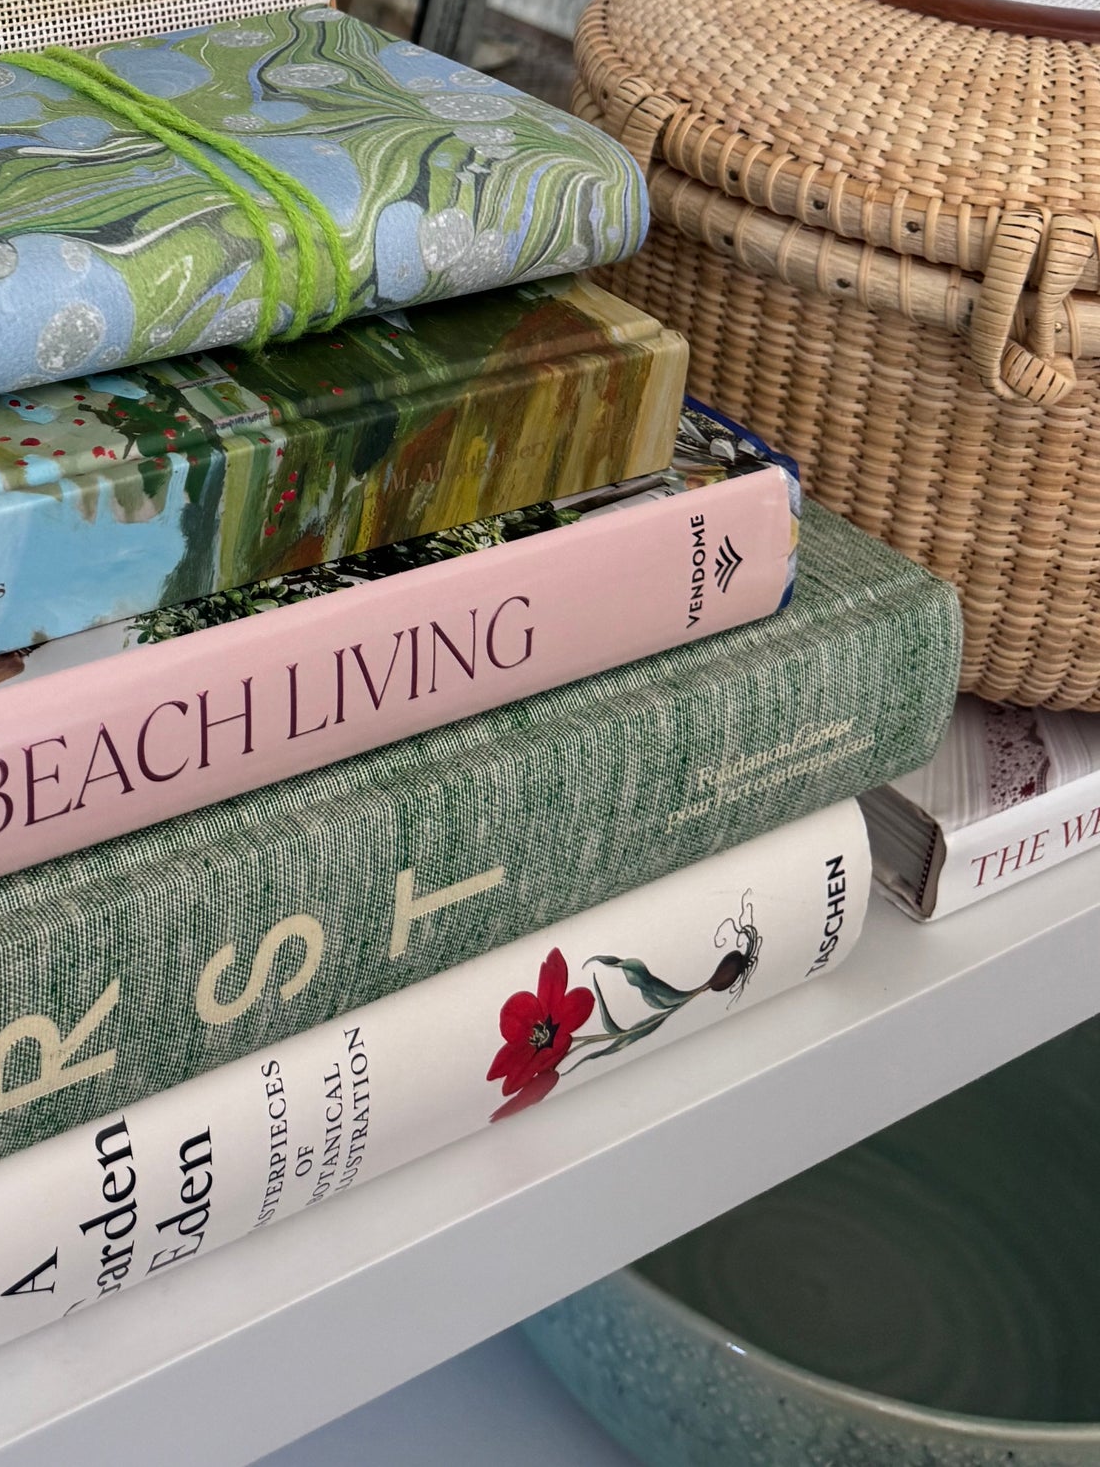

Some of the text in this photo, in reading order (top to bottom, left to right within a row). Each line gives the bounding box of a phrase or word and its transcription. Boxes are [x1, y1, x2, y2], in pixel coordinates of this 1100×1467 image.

[685, 513, 707, 630] VENDOME
[285, 594, 536, 740] LIVING
[804, 854, 846, 978] TASCHEN
[969, 828, 1050, 889] THE
[144, 1125, 214, 1277] Eden
[253, 1059, 288, 1228] ASTERPIECES
[295, 1145, 315, 1177] OF
[0, 1245, 59, 1297] A
